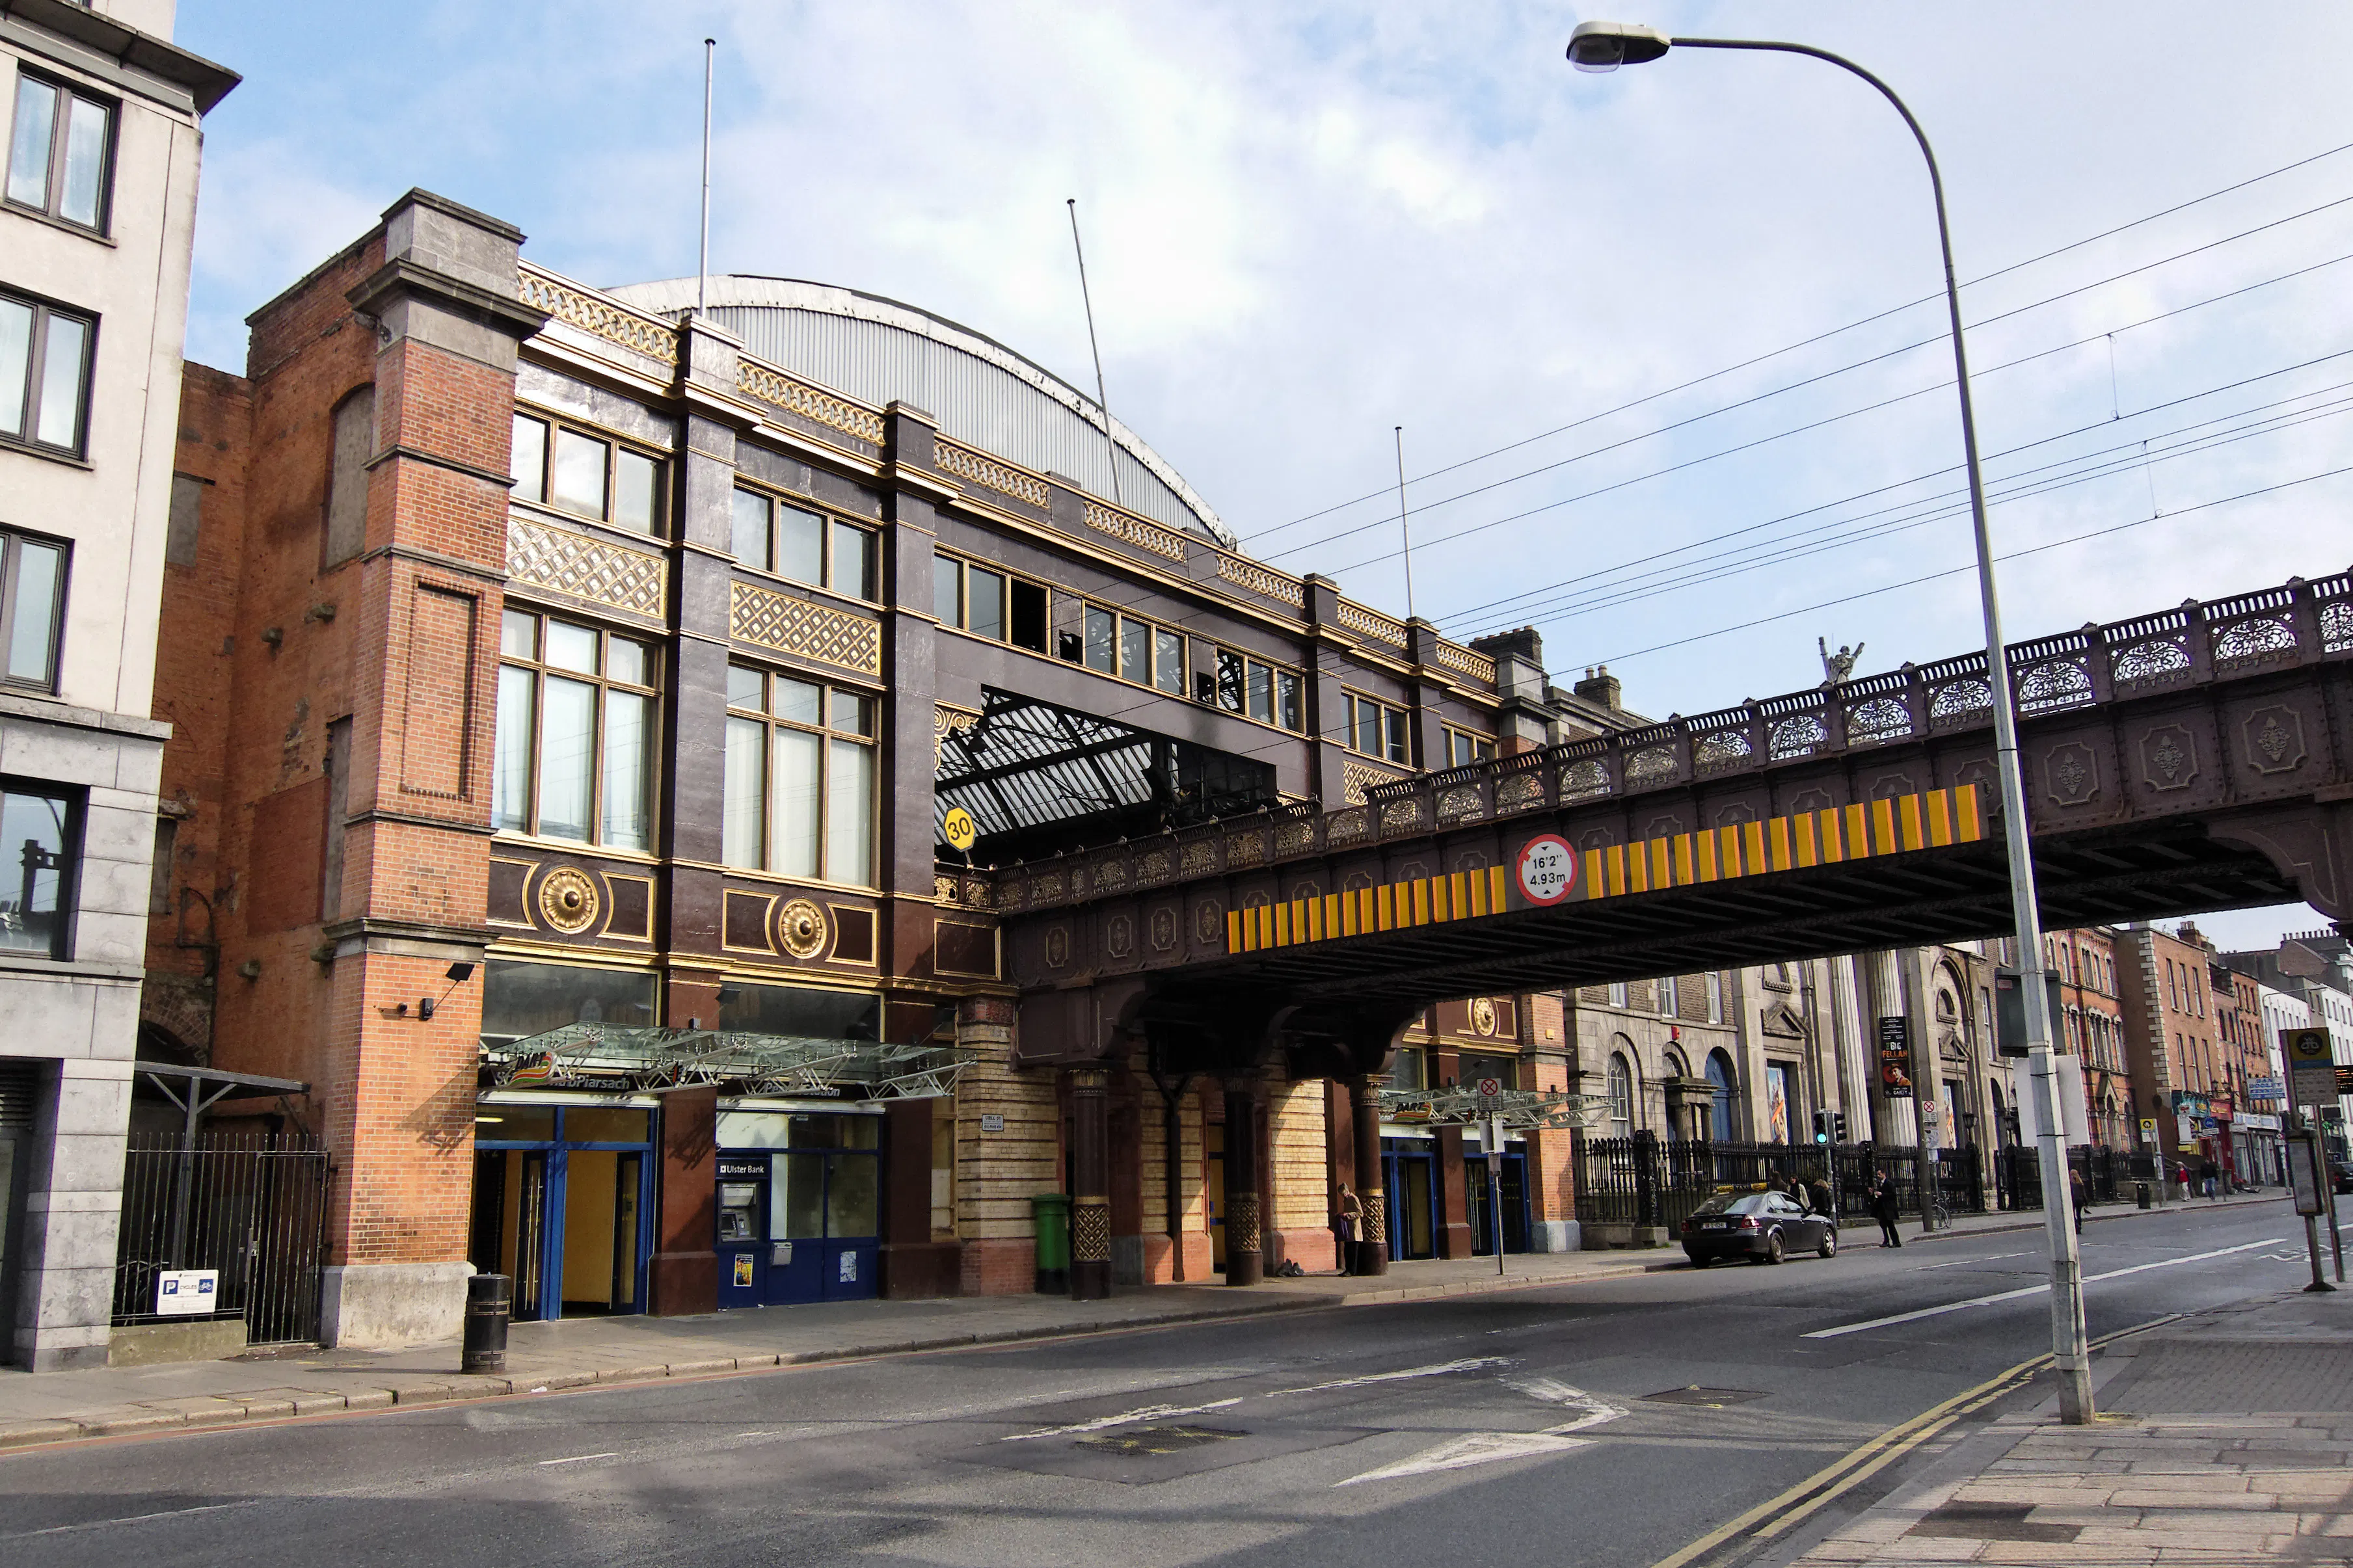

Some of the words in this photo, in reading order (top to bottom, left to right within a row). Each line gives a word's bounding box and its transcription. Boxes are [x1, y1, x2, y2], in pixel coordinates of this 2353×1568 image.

[948, 817, 971, 840] 30
[1530, 872, 1565, 885] 4.93m
[1395, 1102, 1426, 1113] DART
[727, 1165, 747, 1173] Ulster
[747, 1165, 764, 1173] Bank
